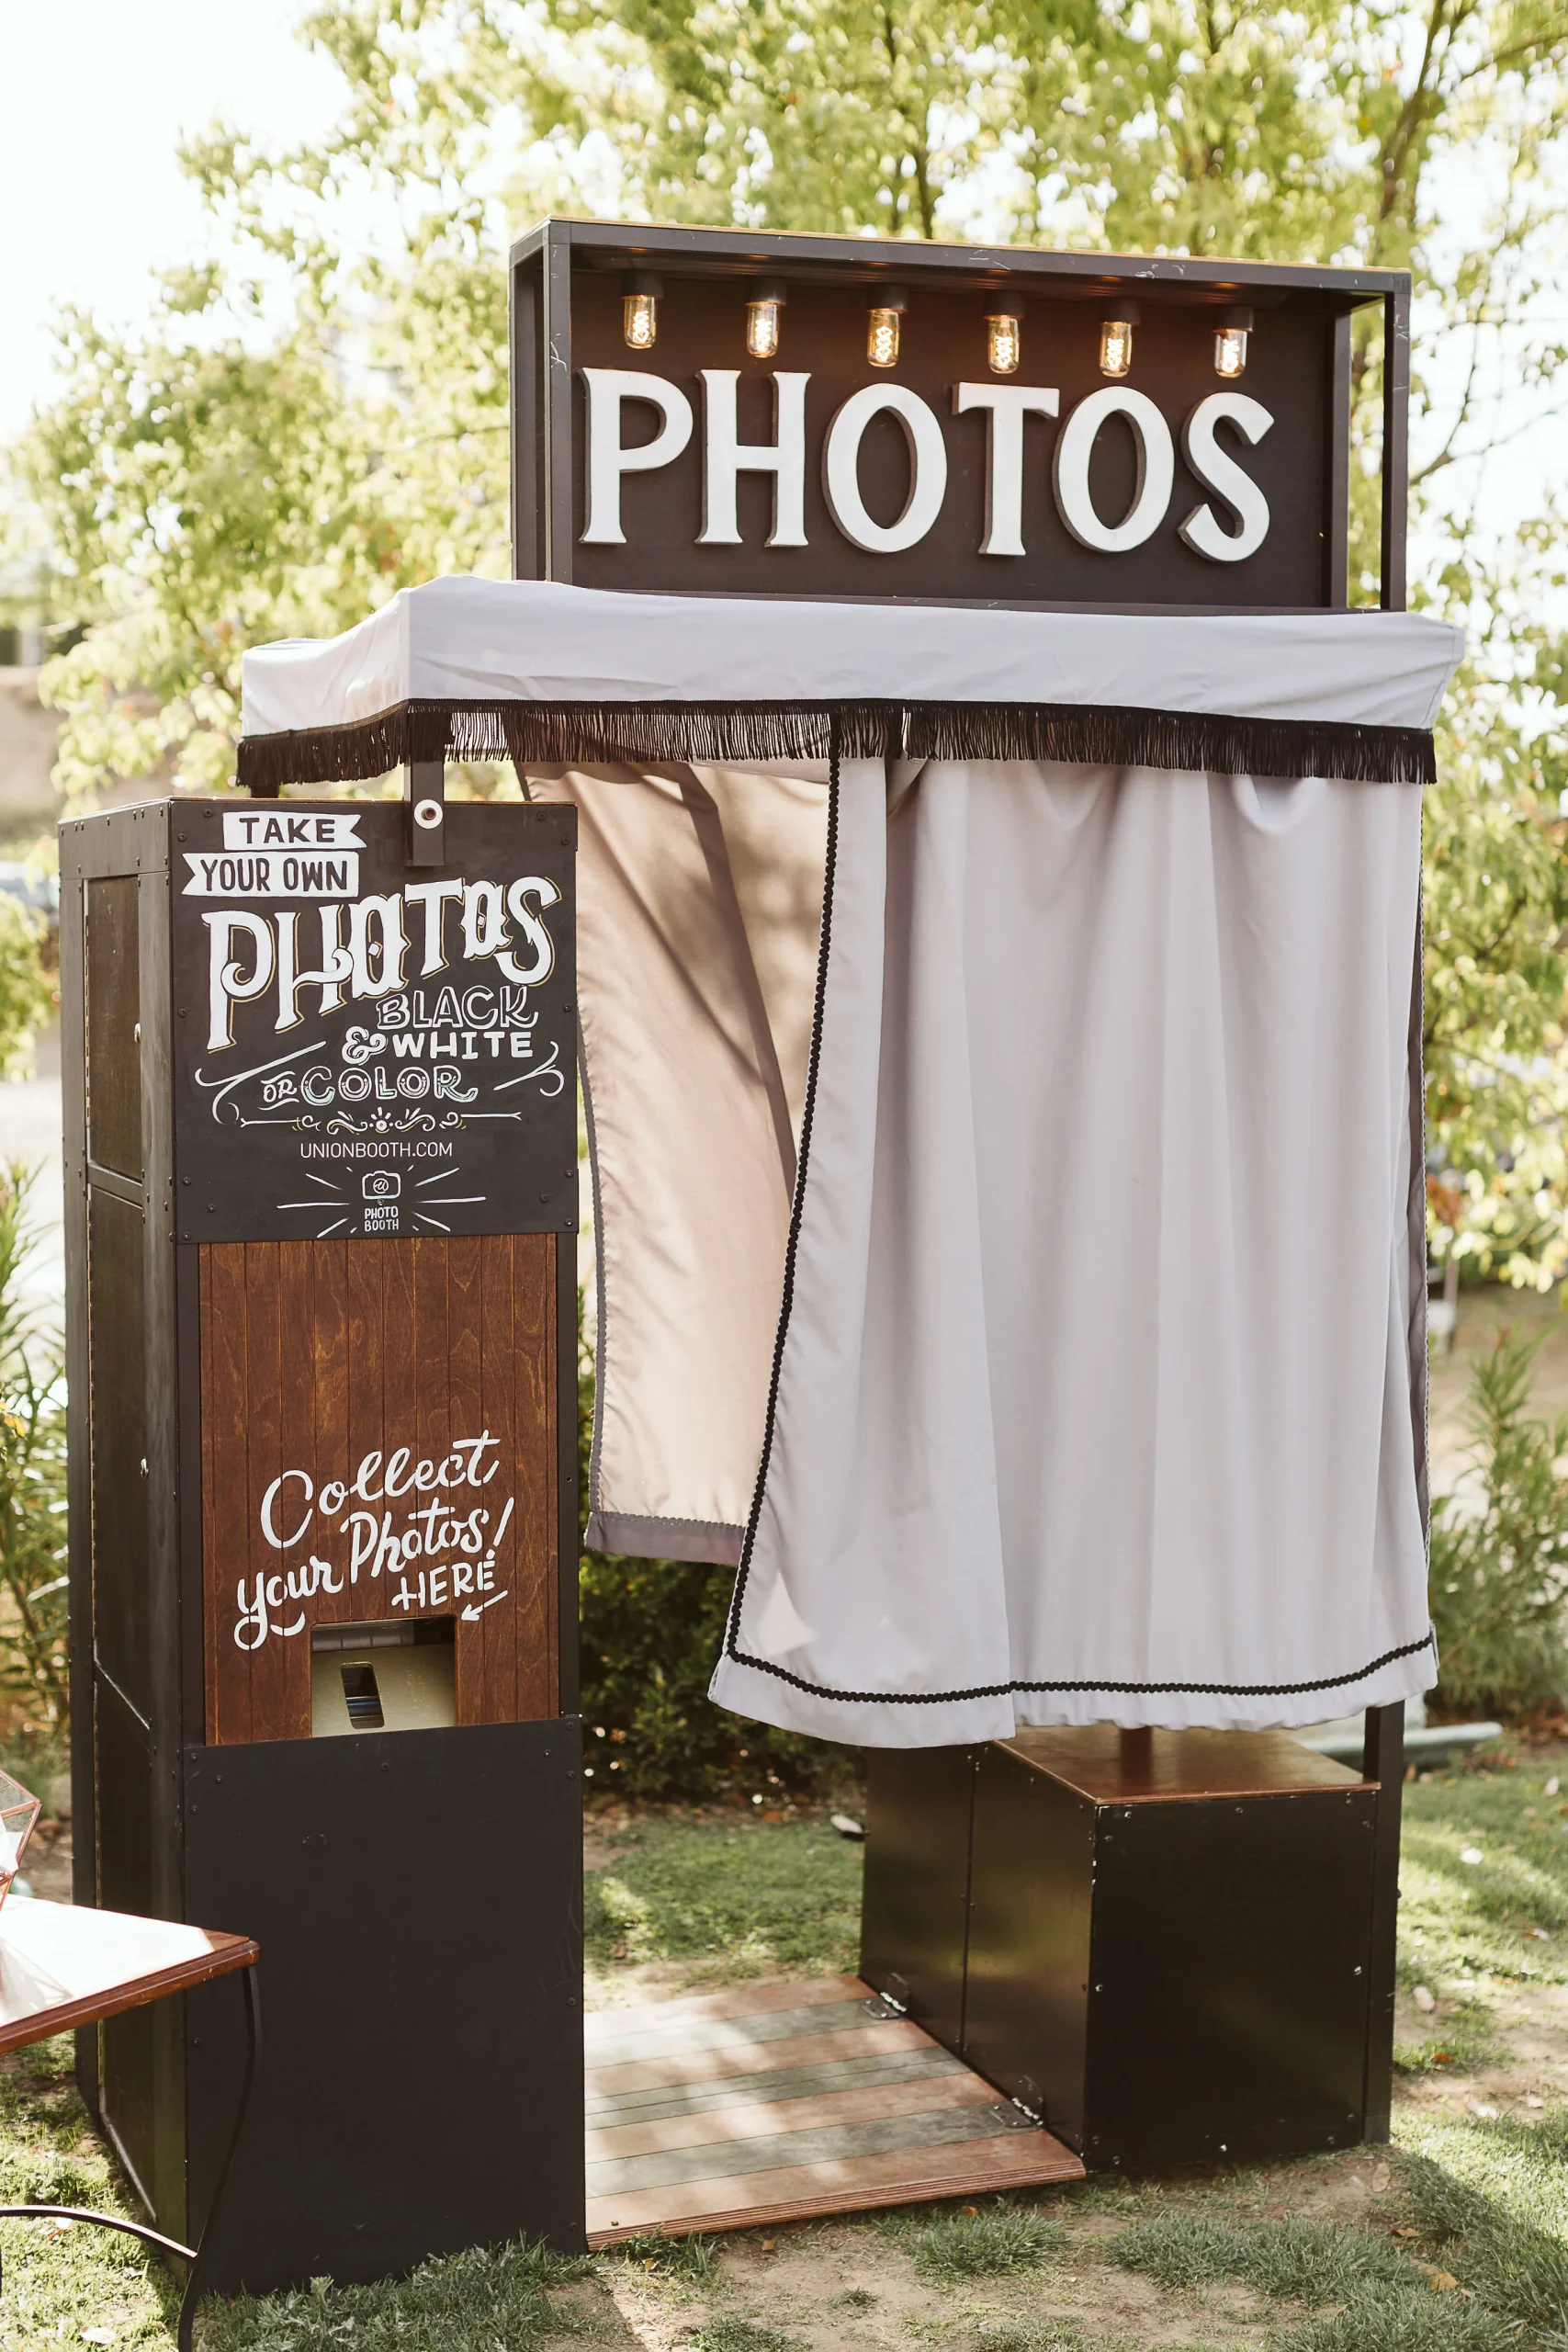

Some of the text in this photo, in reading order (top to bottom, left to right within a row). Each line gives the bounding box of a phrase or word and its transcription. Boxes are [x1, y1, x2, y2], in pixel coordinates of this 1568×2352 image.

[579, 368, 1275, 562] PHOTOS
[239, 817, 337, 844] TAKE
[200, 857, 348, 892] YOUR OWN
[201, 876, 562, 1052] PHOTOS
[376, 985, 540, 1031] BLACK
[341, 1025, 534, 1066] & WHITE
[262, 1065, 479, 1106] OR COLOR
[299, 1141, 454, 1159] UNIONBOOTH.COM
[364, 1205, 400, 1220] PHOTO
[364, 1218, 400, 1232] BOOTH
[260, 1429, 501, 1549] Collect
[339, 1496, 514, 1584] Photos!
[391, 1560, 496, 1611] HERE
